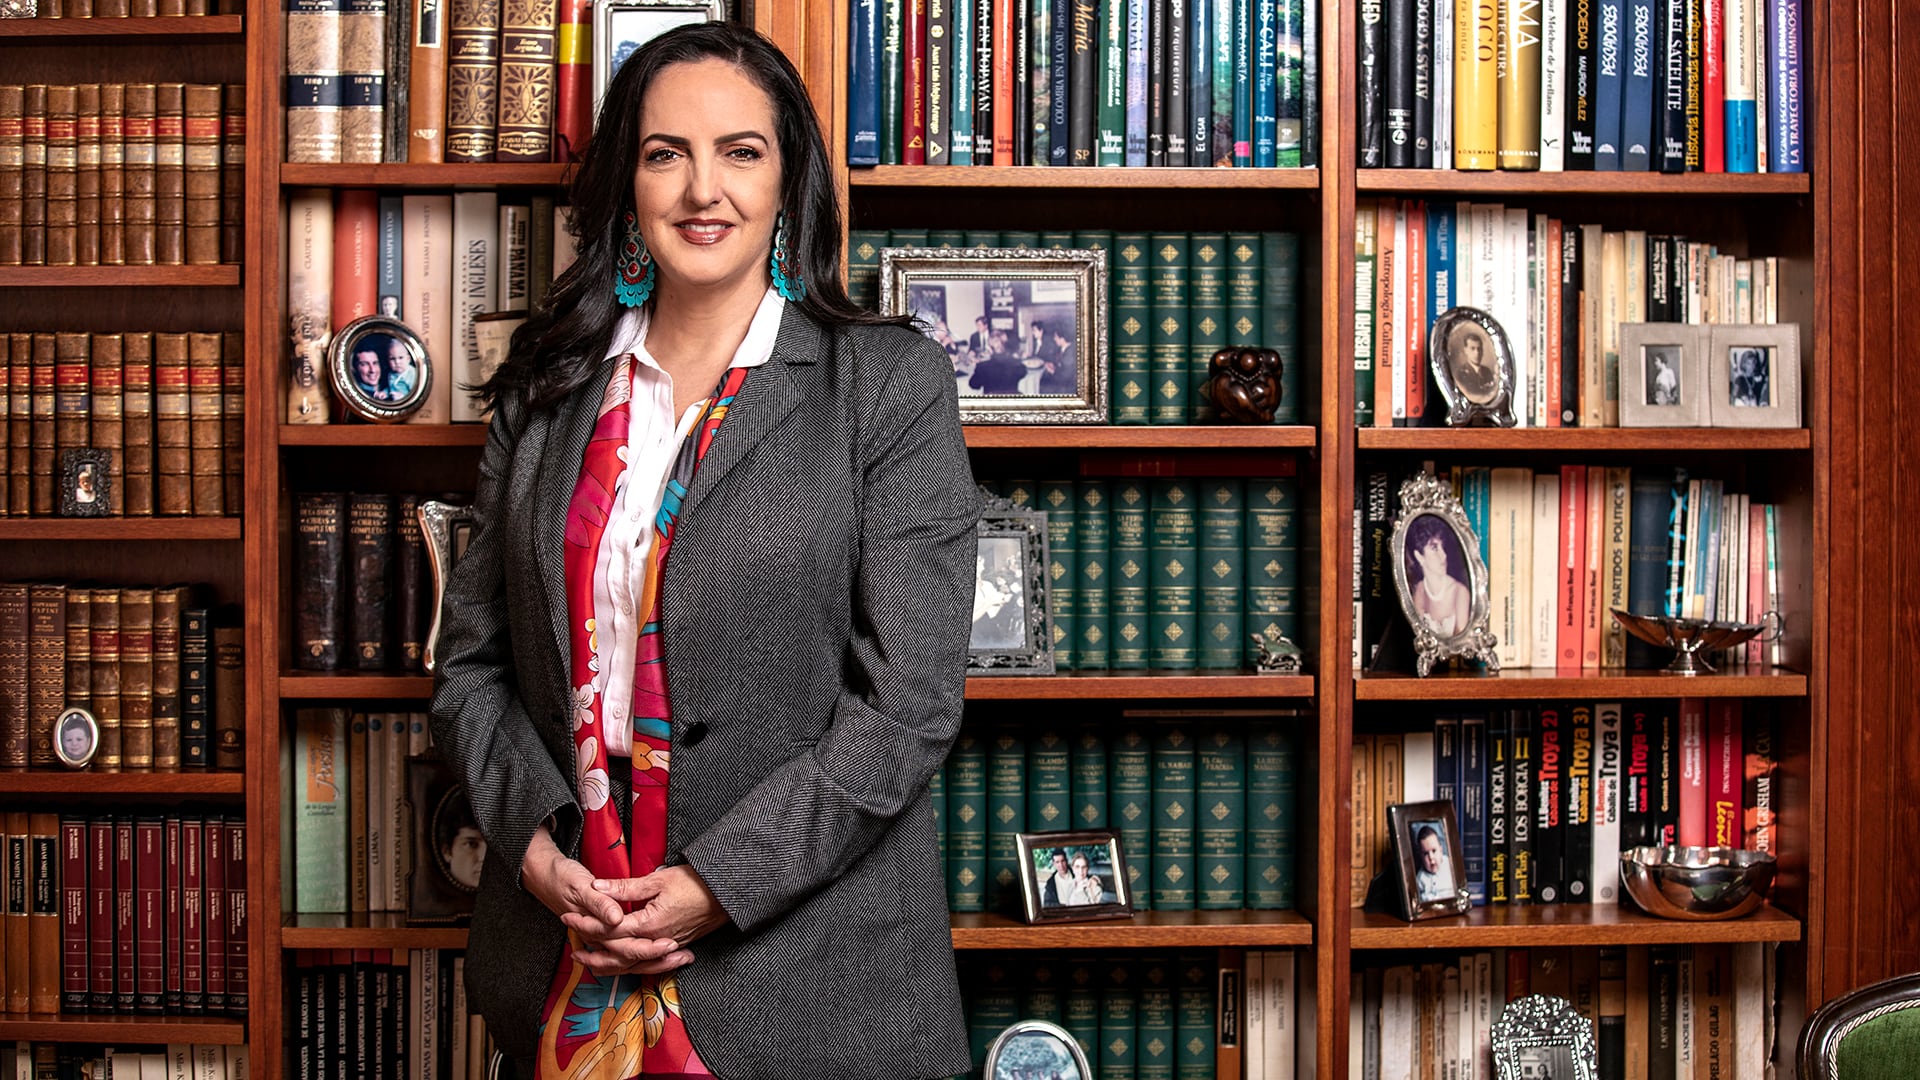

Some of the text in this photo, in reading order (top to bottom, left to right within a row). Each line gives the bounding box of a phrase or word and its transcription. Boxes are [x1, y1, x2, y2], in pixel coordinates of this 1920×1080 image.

[1172, 26, 1182, 96] Arquitectura
[1260, 28, 1274, 68] CALI
[1416, 40, 1429, 50] Y
[1601, 4, 1618, 76] PESCADORES
[1633, 5, 1649, 77] PESCADORES
[1055, 31, 1064, 124] COLOMBIA EN LA ONU
[1416, 54, 1429, 100] ATLAS
[1788, 3, 1800, 164] LA TRAYECTORIA LUMINOSA
[1074, 149, 1090, 160] SP
[1686, 117, 1700, 166] Historia
[468, 240, 486, 298] INGLESES
[1354, 260, 1372, 311] MUNDIAL
[1354, 358, 1372, 370] EL
[1370, 488, 1378, 521] HACIA
[1378, 488, 1386, 521] SIGLO
[1612, 548, 1622, 606] PARTIDOS
[1514, 738, 1530, 759] II
[1538, 710, 1560, 780] Troya 2)
[1570, 707, 1590, 778] Troya 3)
[1599, 710, 1618, 779] Troya 4)
[1628, 734, 1649, 775] Troya
[1492, 764, 1504, 844] LOS BORGIA
[1515, 762, 1528, 842] LOS BORGIA
[1549, 780, 1558, 826] Caballo de
[1580, 777, 1588, 822] Caballo de
[1607, 779, 1616, 823] Caballo de
[1756, 778, 1770, 852] OHN GRISHAM
[1682, 1024, 1690, 1050] NOCHE
[1708, 1006, 1719, 1038] GULAG
[1682, 1050, 1690, 1061] LA
